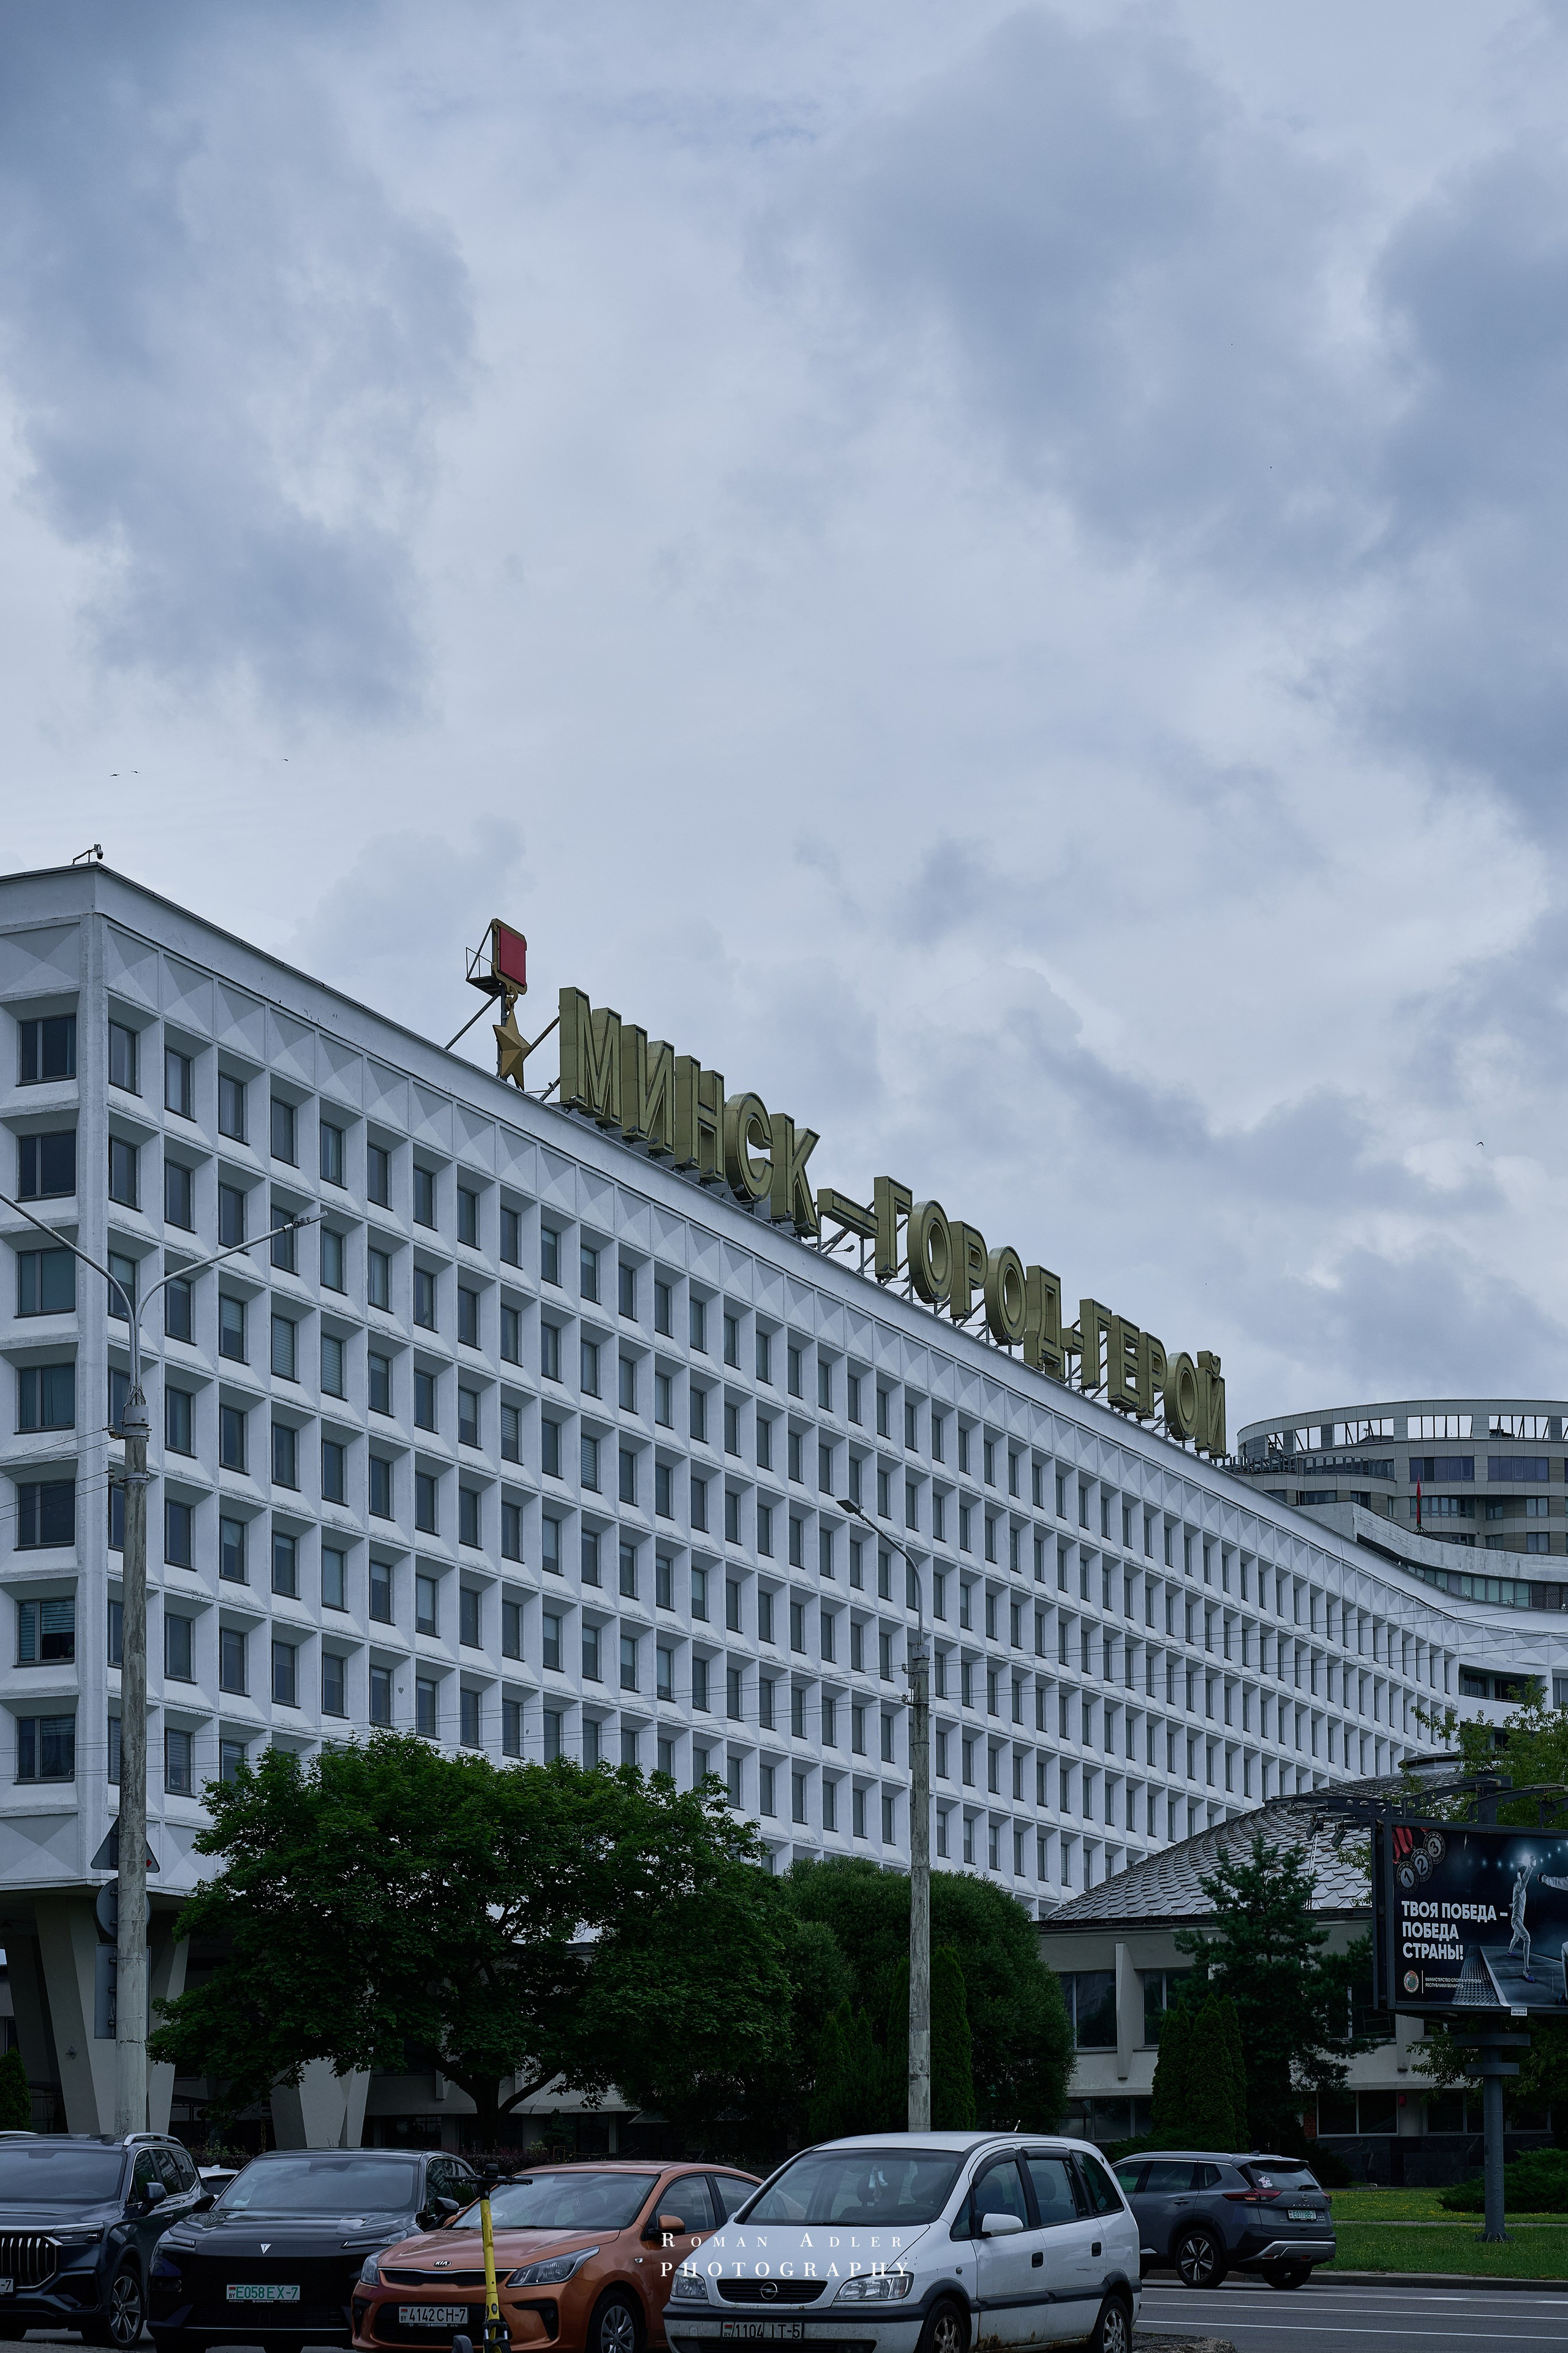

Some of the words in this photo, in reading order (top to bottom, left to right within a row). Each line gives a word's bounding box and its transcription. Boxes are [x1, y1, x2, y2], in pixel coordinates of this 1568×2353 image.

[559, 987, 821, 1237] МИНСК
[1430, 1841, 1439, 1854] 3
[1417, 1858, 1427, 1874] 2
[1404, 1870, 1412, 1884] 1
[1401, 1900, 1438, 1918] ТВОЯ
[1442, 1903, 1497, 1923] ПОБЕДА
[1402, 1921, 1459, 1941] ПОБЕДА
[1403, 1942, 1464, 1960] СТРАНЫ!
